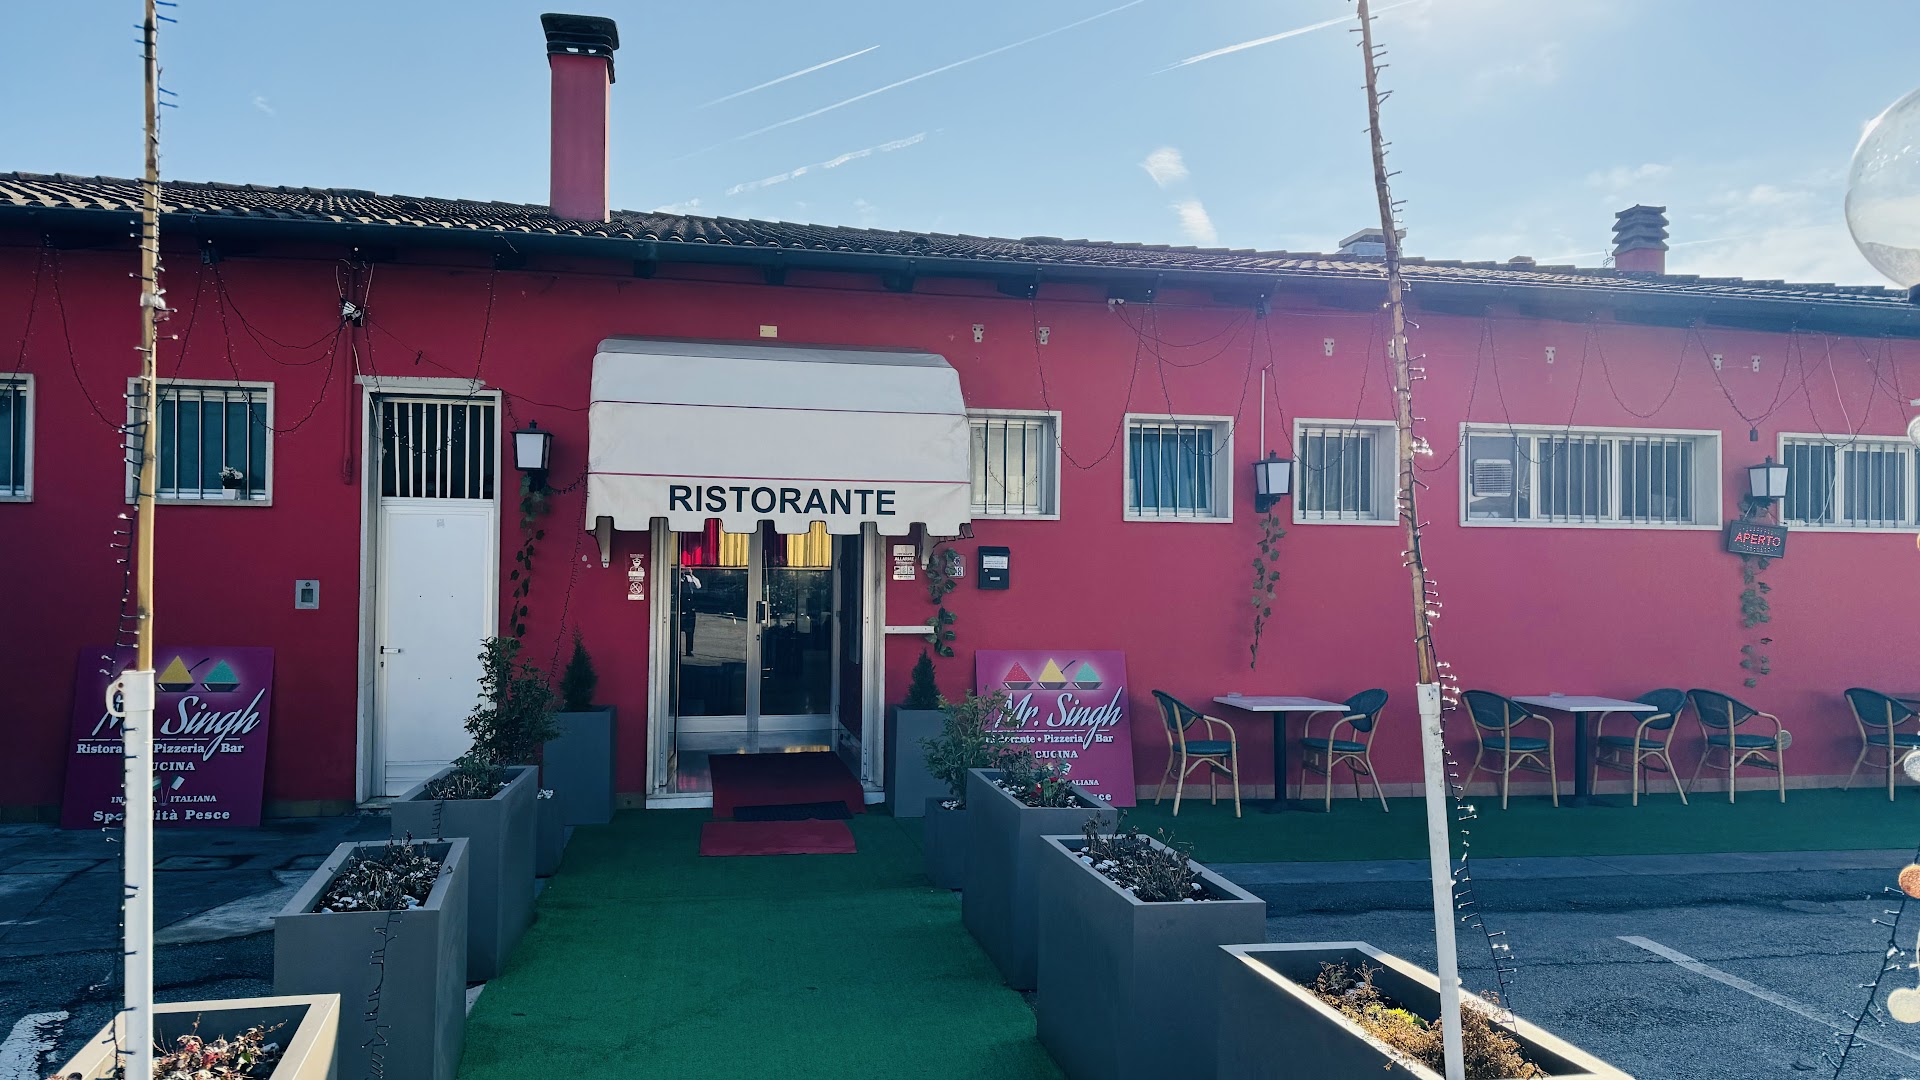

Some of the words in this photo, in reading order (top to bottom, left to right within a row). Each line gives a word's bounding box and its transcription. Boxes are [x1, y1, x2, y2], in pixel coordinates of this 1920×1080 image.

[669, 484, 896, 516] RISTORANTE
[1735, 532, 1781, 547] APERTO
[1046, 686, 1123, 750] Singh
[160, 688, 266, 761] Singh
[1044, 734, 1083, 743] Pizzeria
[1095, 734, 1114, 743] Bar
[76, 743, 122, 754] Ristora
[154, 743, 204, 753] Pizzeria
[220, 743, 244, 753] Bar
[1035, 750, 1079, 758] CUCINA
[152, 762, 196, 771] UCINA
[170, 795, 217, 803] ITALIANA
[185, 809, 230, 820] Pesce
